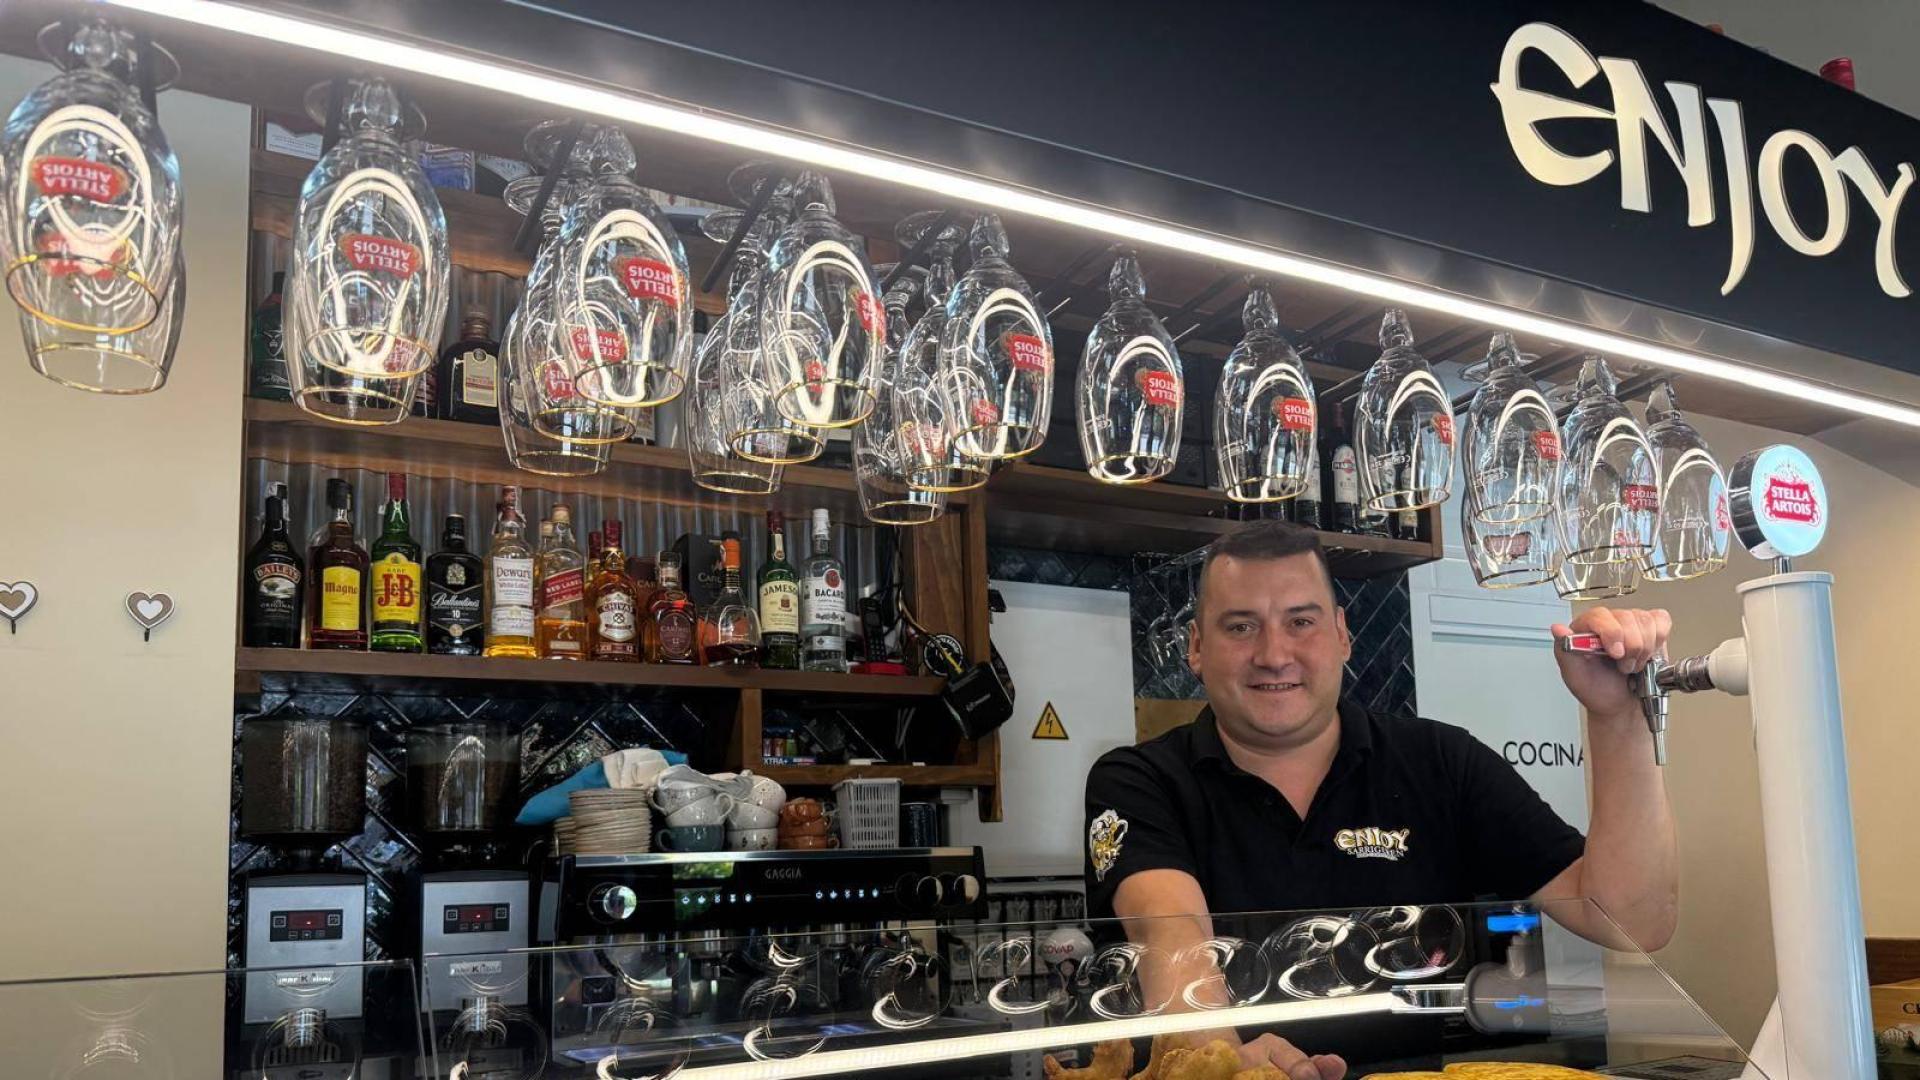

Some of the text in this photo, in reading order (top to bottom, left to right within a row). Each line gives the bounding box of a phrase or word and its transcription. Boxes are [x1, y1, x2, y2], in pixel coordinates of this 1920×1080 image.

[1490, 22, 1916, 298] ENJOY
[42, 163, 112, 183] ARTOIS
[43, 176, 111, 197] STELLA
[353, 240, 411, 260] ARTOIS
[354, 252, 409, 273] STELLA
[576, 332, 621, 347] ARTIS
[578, 341, 621, 357] STELA
[1014, 341, 1045, 356] RTOIS
[1015, 352, 1046, 368] TELLA
[1149, 377, 1176, 391] RTOIS
[1149, 388, 1177, 402] TELLA
[1284, 404, 1310, 417] RTOIS
[1284, 413, 1313, 427] TELLA
[1771, 486, 1809, 502] STELLA
[1771, 501, 1812, 516] ARTOIS
[377, 573, 415, 607] J&B
[763, 584, 797, 596] JAMES
[452, 610, 461, 618] 10
[1333, 826, 1410, 852] ENJOY
